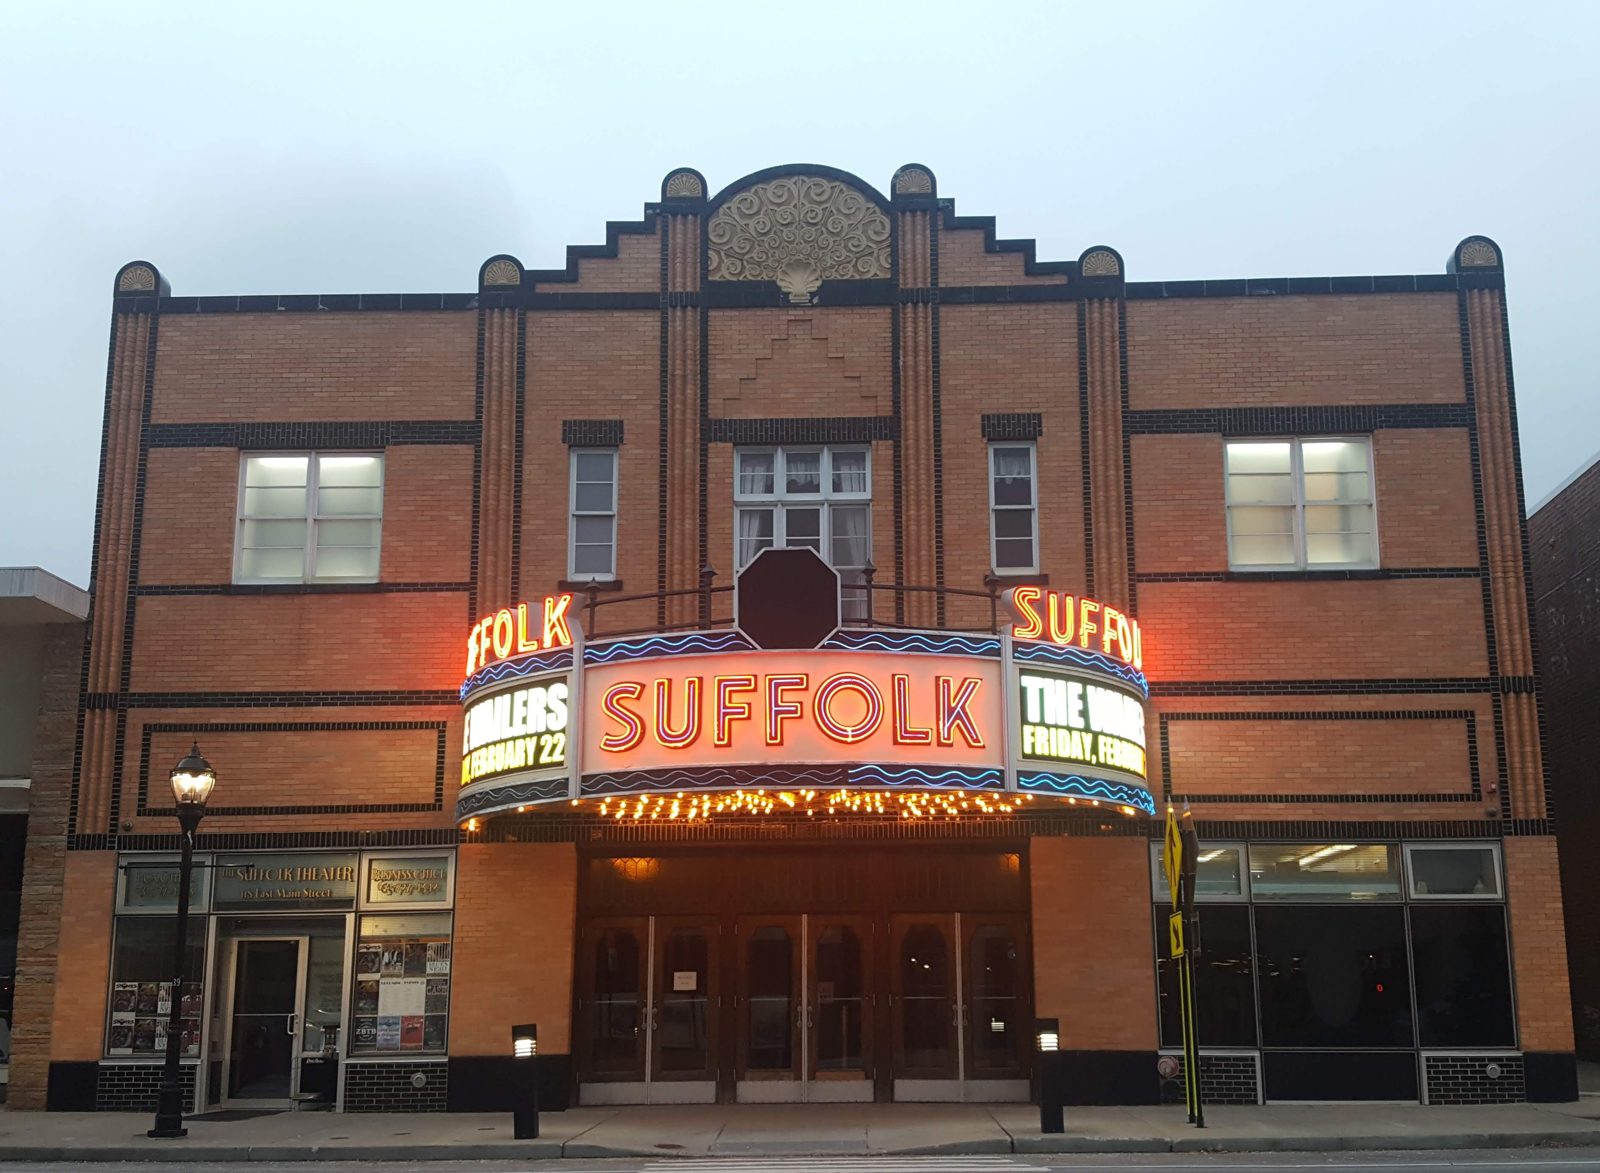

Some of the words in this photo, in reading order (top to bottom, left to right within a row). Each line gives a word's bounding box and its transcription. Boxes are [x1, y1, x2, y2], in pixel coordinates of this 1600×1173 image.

[469, 683, 568, 750] WAILERS
[599, 671, 986, 753] SUFFOLK
[1020, 675, 1085, 729] THE
[470, 735, 538, 779] FEBRUARY
[538, 732, 566, 765] 22
[1022, 725, 1097, 765] FRIDAY,
[297, 866, 354, 882] THEATER
[303, 887, 333, 898] Street
[173, 978, 181, 987] 39
